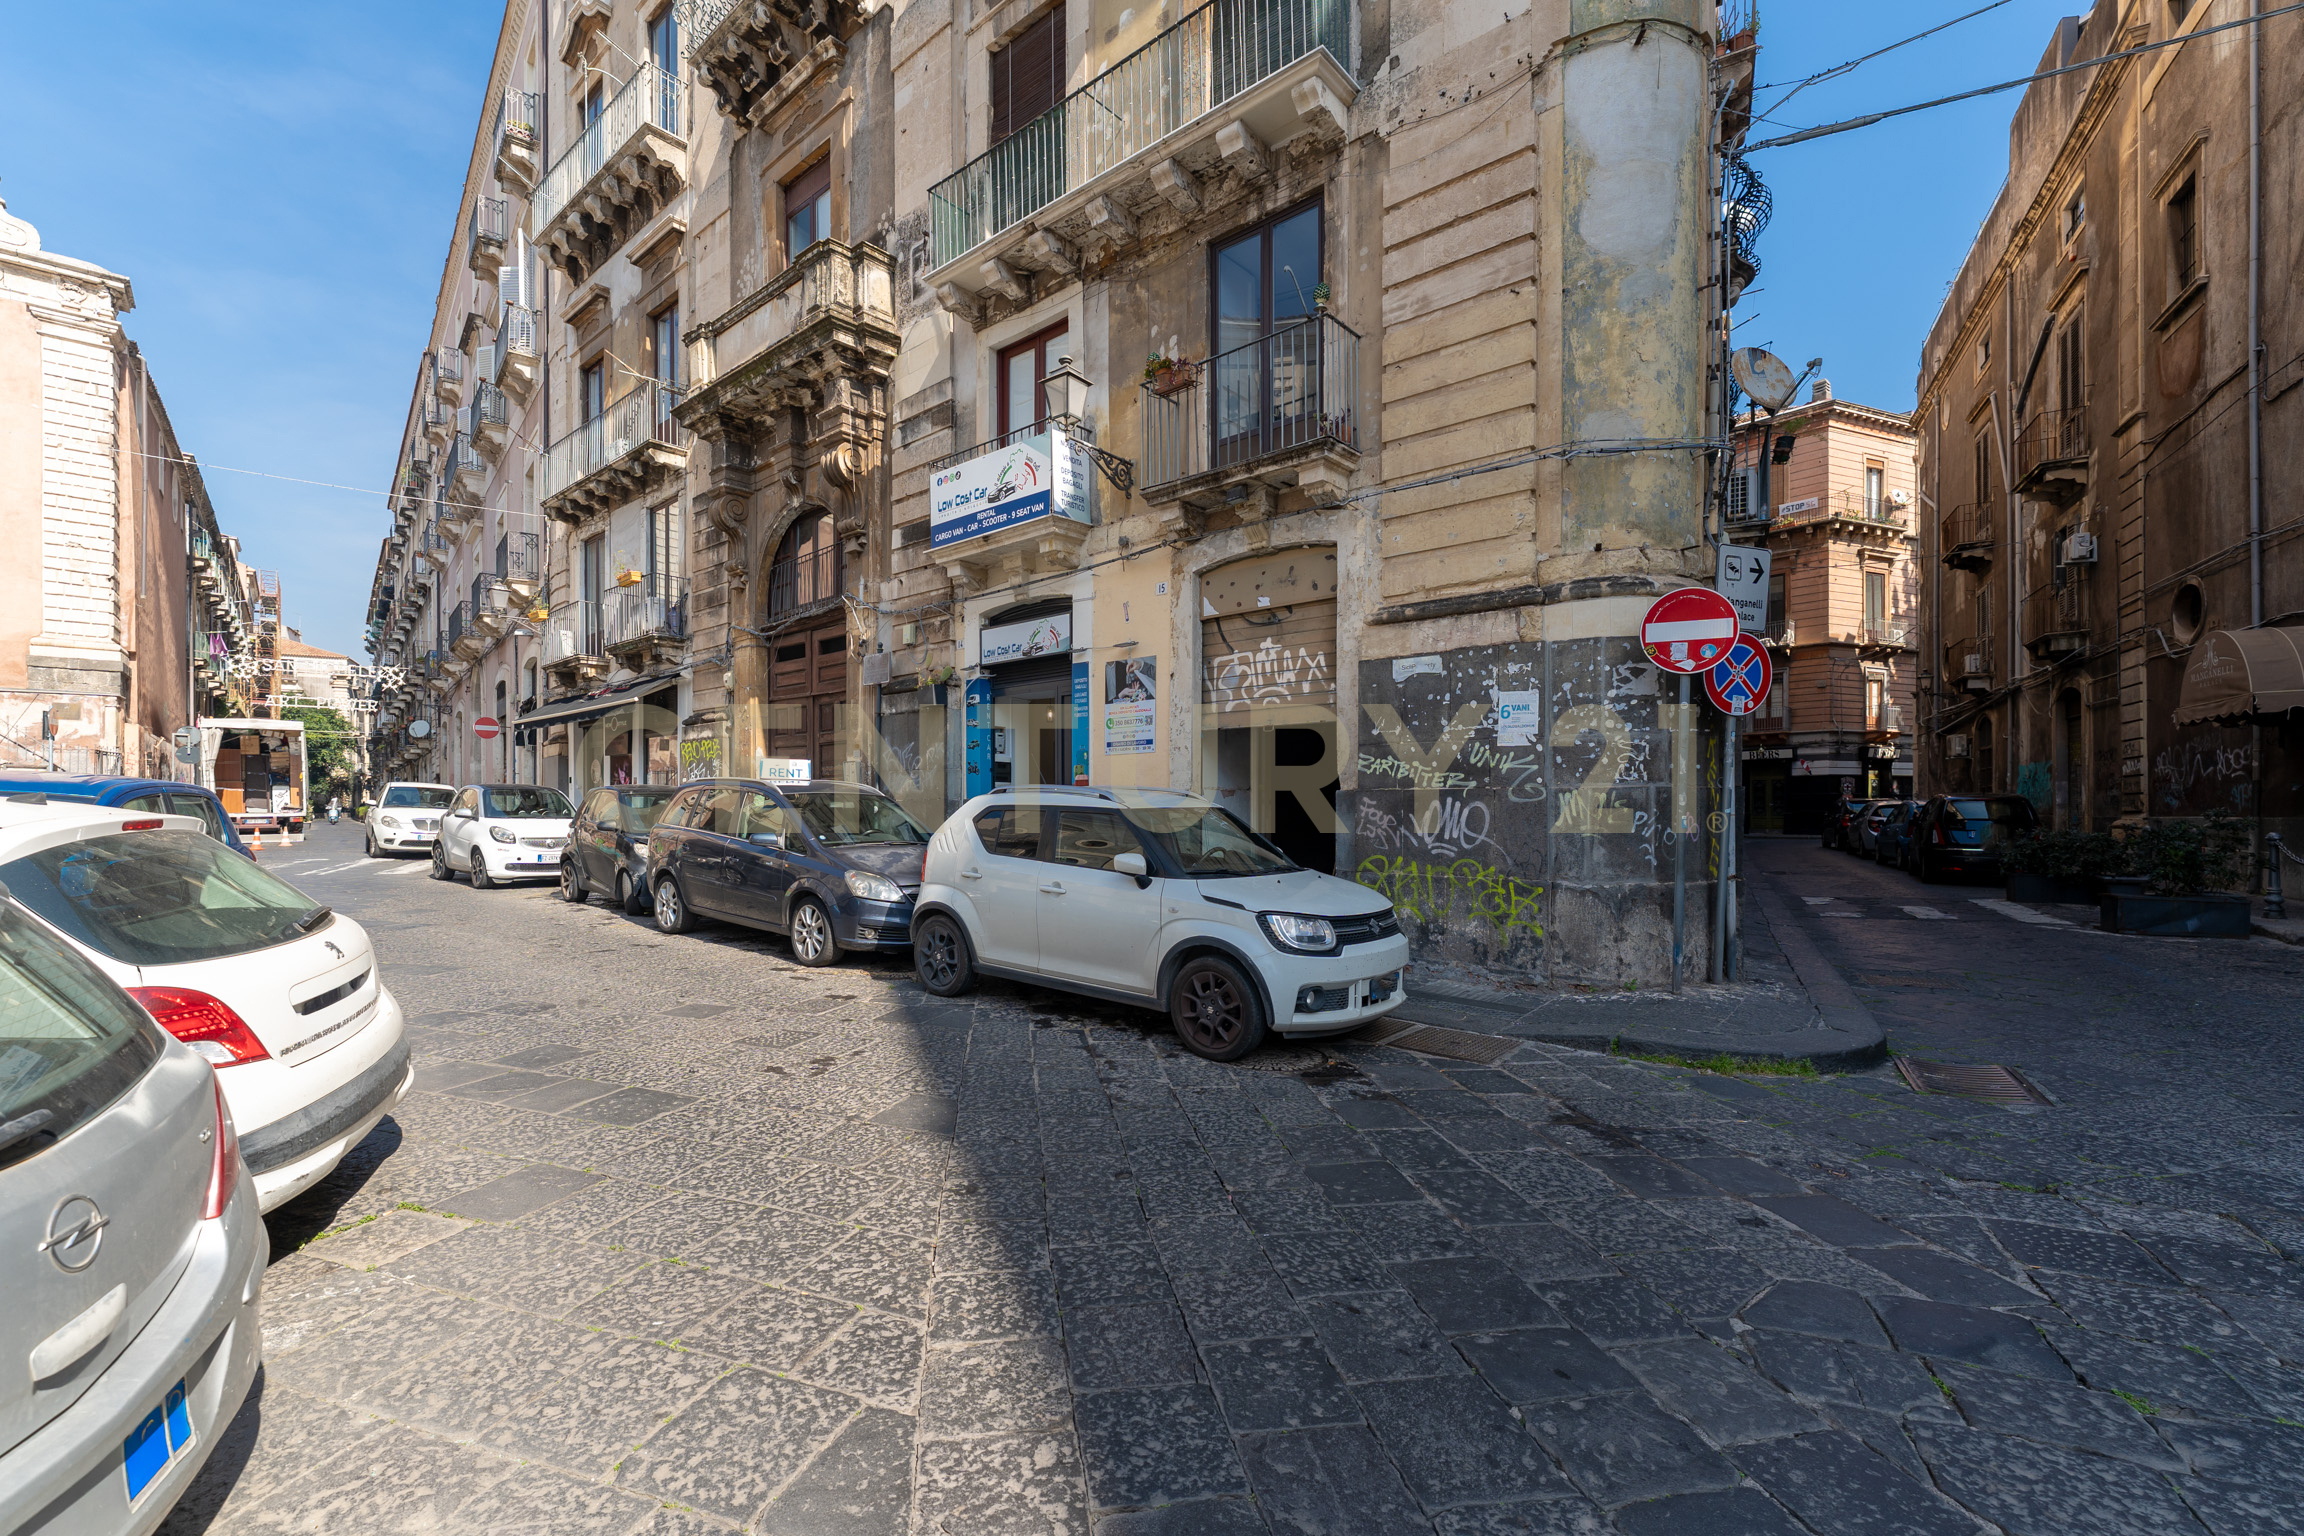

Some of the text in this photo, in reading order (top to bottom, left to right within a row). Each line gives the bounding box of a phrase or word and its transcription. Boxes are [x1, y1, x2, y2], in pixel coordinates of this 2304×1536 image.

[1062, 454, 1083, 467] VENDITA
[1061, 467, 1084, 481] DEPOSITO
[938, 487, 988, 512] Low Cost Car
[1061, 490, 1085, 504] TRANSFER
[1061, 498, 1085, 512] TURISTICO
[935, 502, 1045, 541] CARGO VAN CAR SCOOTER 9 SEAT VAN
[976, 508, 996, 521] RENTAL
[1158, 583, 1166, 594] 15
[1727, 596, 1763, 610] anganelli
[1738, 611, 1755, 622] lace
[983, 648, 996, 658] Low
[997, 645, 1011, 656] Cost
[1011, 643, 1023, 653] Car
[2190, 664, 2234, 683] MANGANELLI
[1500, 704, 1511, 719] 6
[1511, 703, 1530, 711] VANI
[1750, 750, 1780, 759] BEERS
[769, 767, 804, 778] RENT
